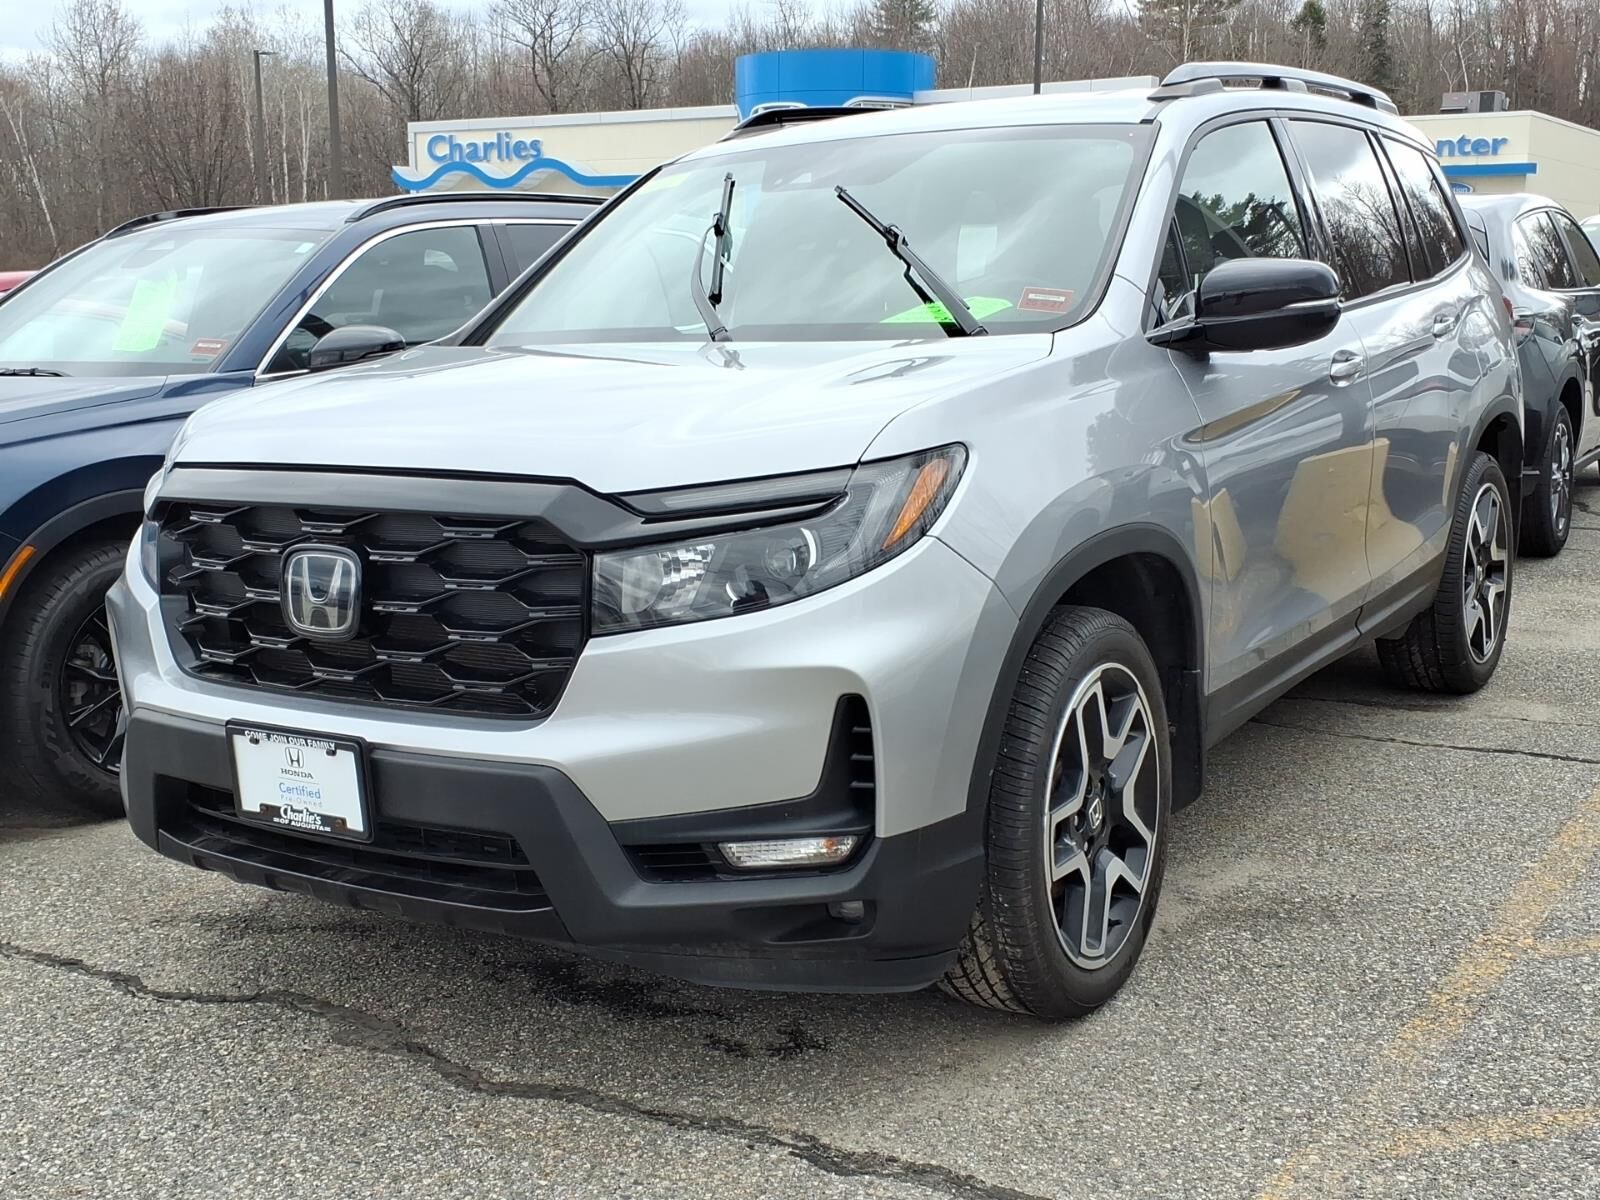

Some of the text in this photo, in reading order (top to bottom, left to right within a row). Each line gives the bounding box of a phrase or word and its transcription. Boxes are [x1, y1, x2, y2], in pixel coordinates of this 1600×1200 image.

[427, 132, 543, 162] Charlies
[244, 730, 335, 750] COME JOIN OUR FAMILY
[280, 768, 314, 779] HONDA
[279, 782, 321, 799] Certified
[280, 805, 322, 825] Charlie's
[291, 820, 324, 830] AUGUSTA
